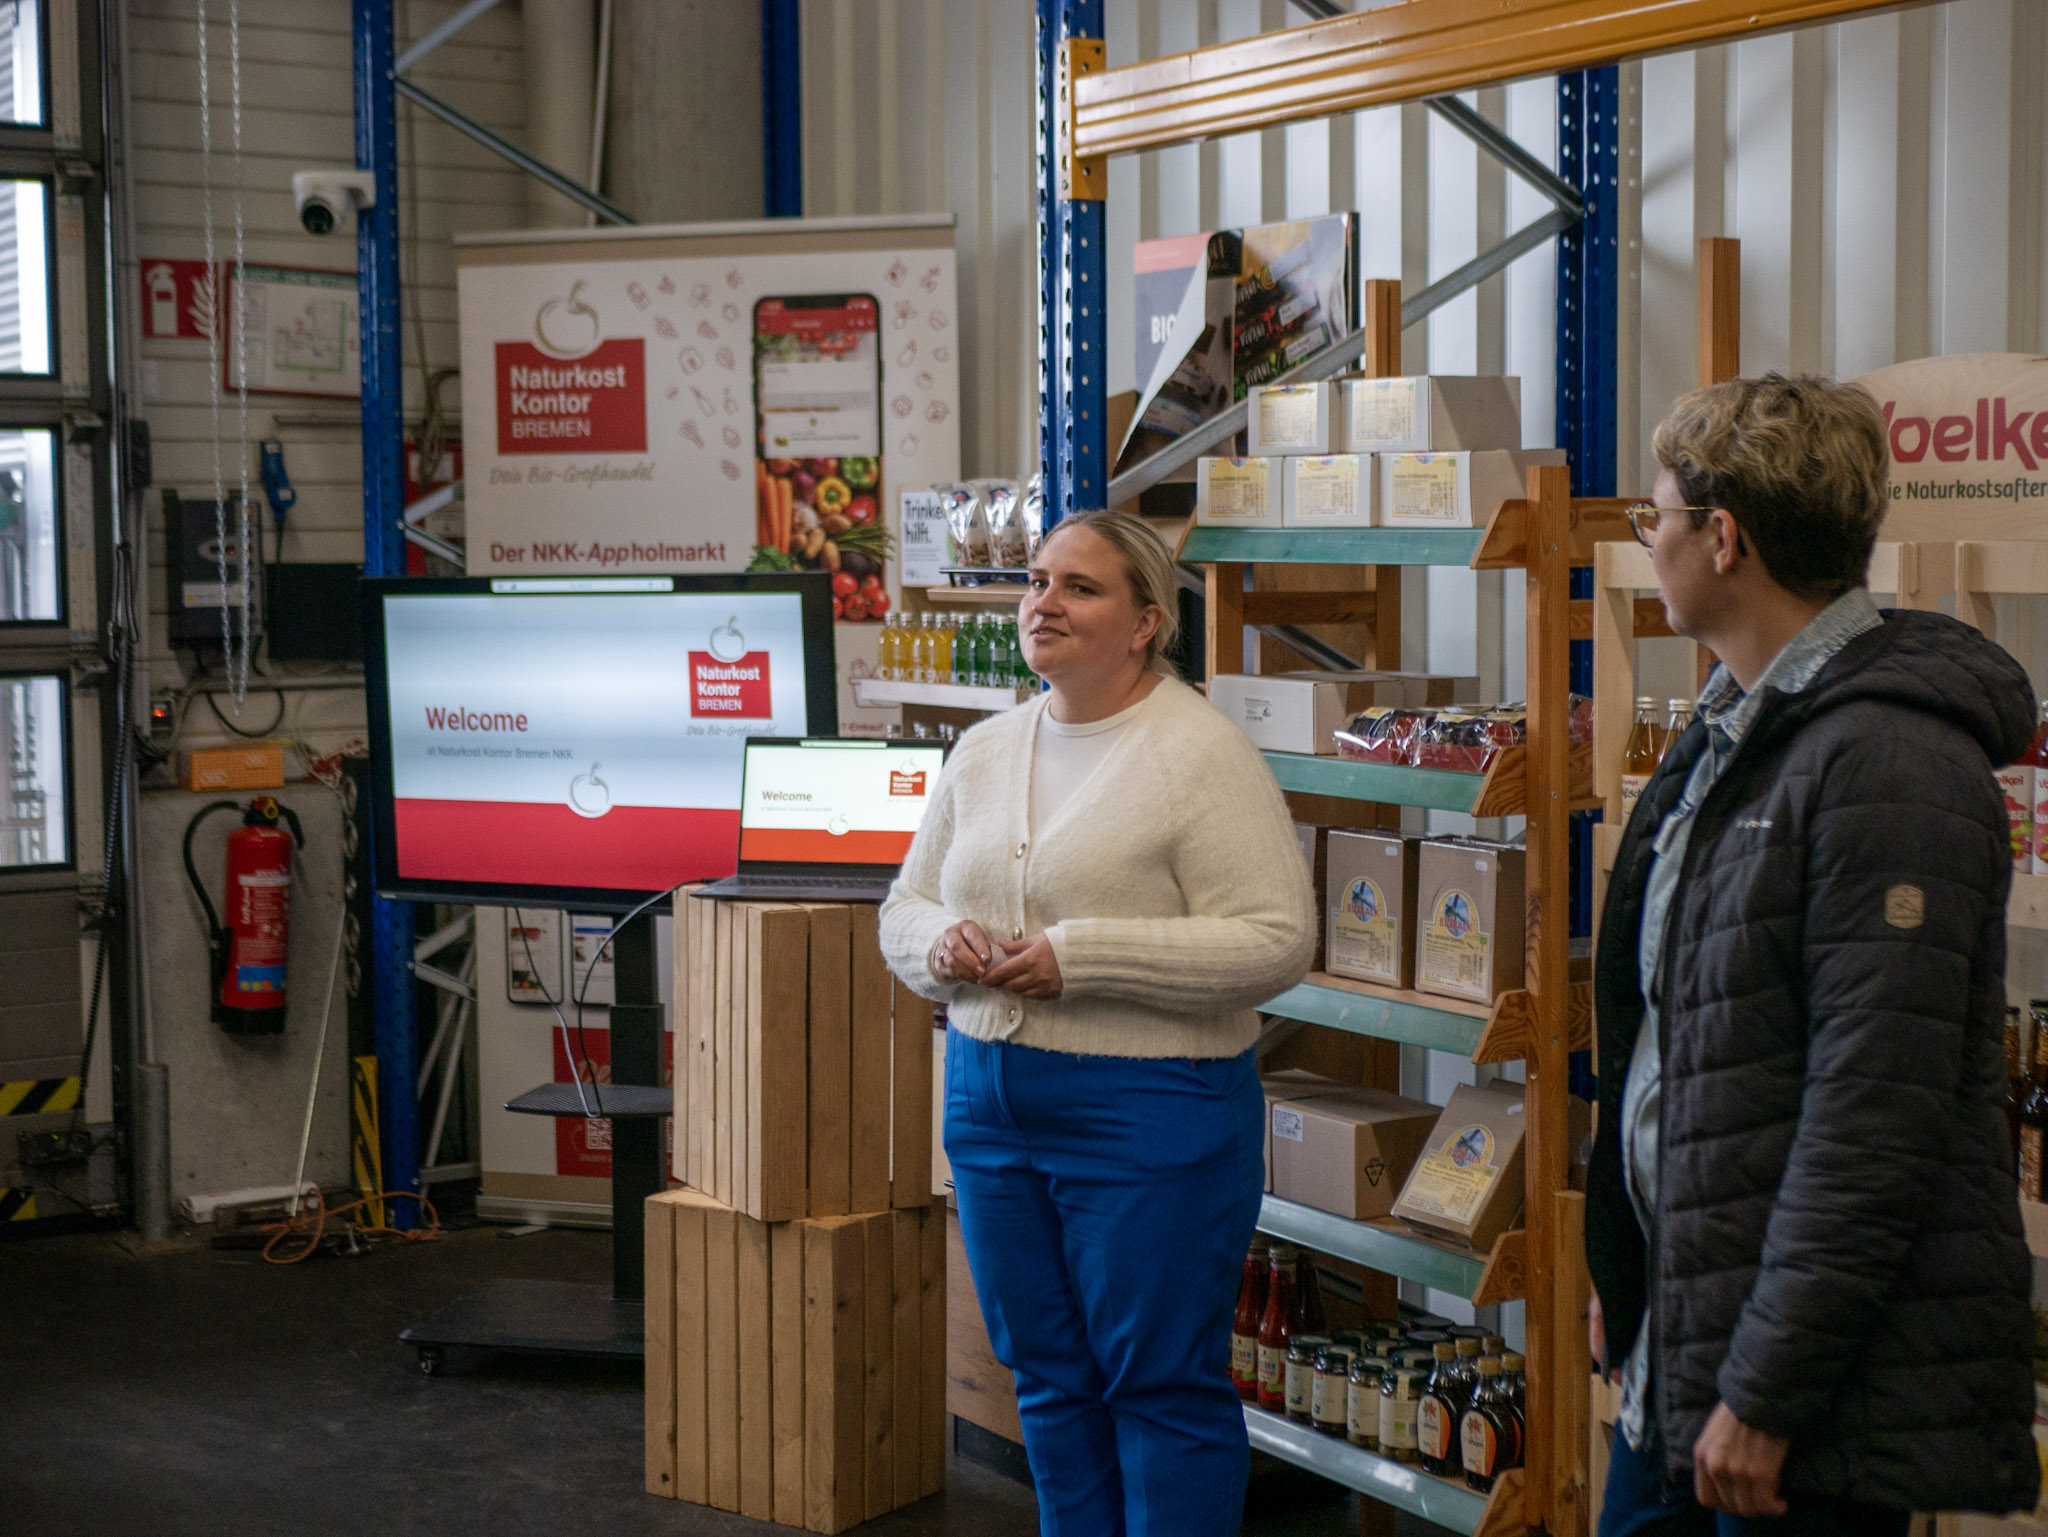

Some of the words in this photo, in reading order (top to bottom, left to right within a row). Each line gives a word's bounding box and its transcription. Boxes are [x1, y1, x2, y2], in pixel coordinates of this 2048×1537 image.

[509, 363, 626, 390] Naturkost
[511, 391, 592, 415] Kontor
[512, 418, 591, 438] BREMEN
[489, 466, 522, 485] Dein
[490, 543, 525, 563] Der
[532, 541, 727, 567] NKK-Appholmarkt
[696, 664, 760, 681] Naturkost
[697, 682, 741, 697] Kontor
[698, 699, 743, 711] BREMEN
[425, 705, 528, 732] Welcome
[438, 746, 481, 758] Naturkost
[483, 747, 513, 759] Kontor
[515, 748, 551, 760] Bremen
[552, 749, 574, 760] NKK
[762, 791, 813, 802] Welcome
